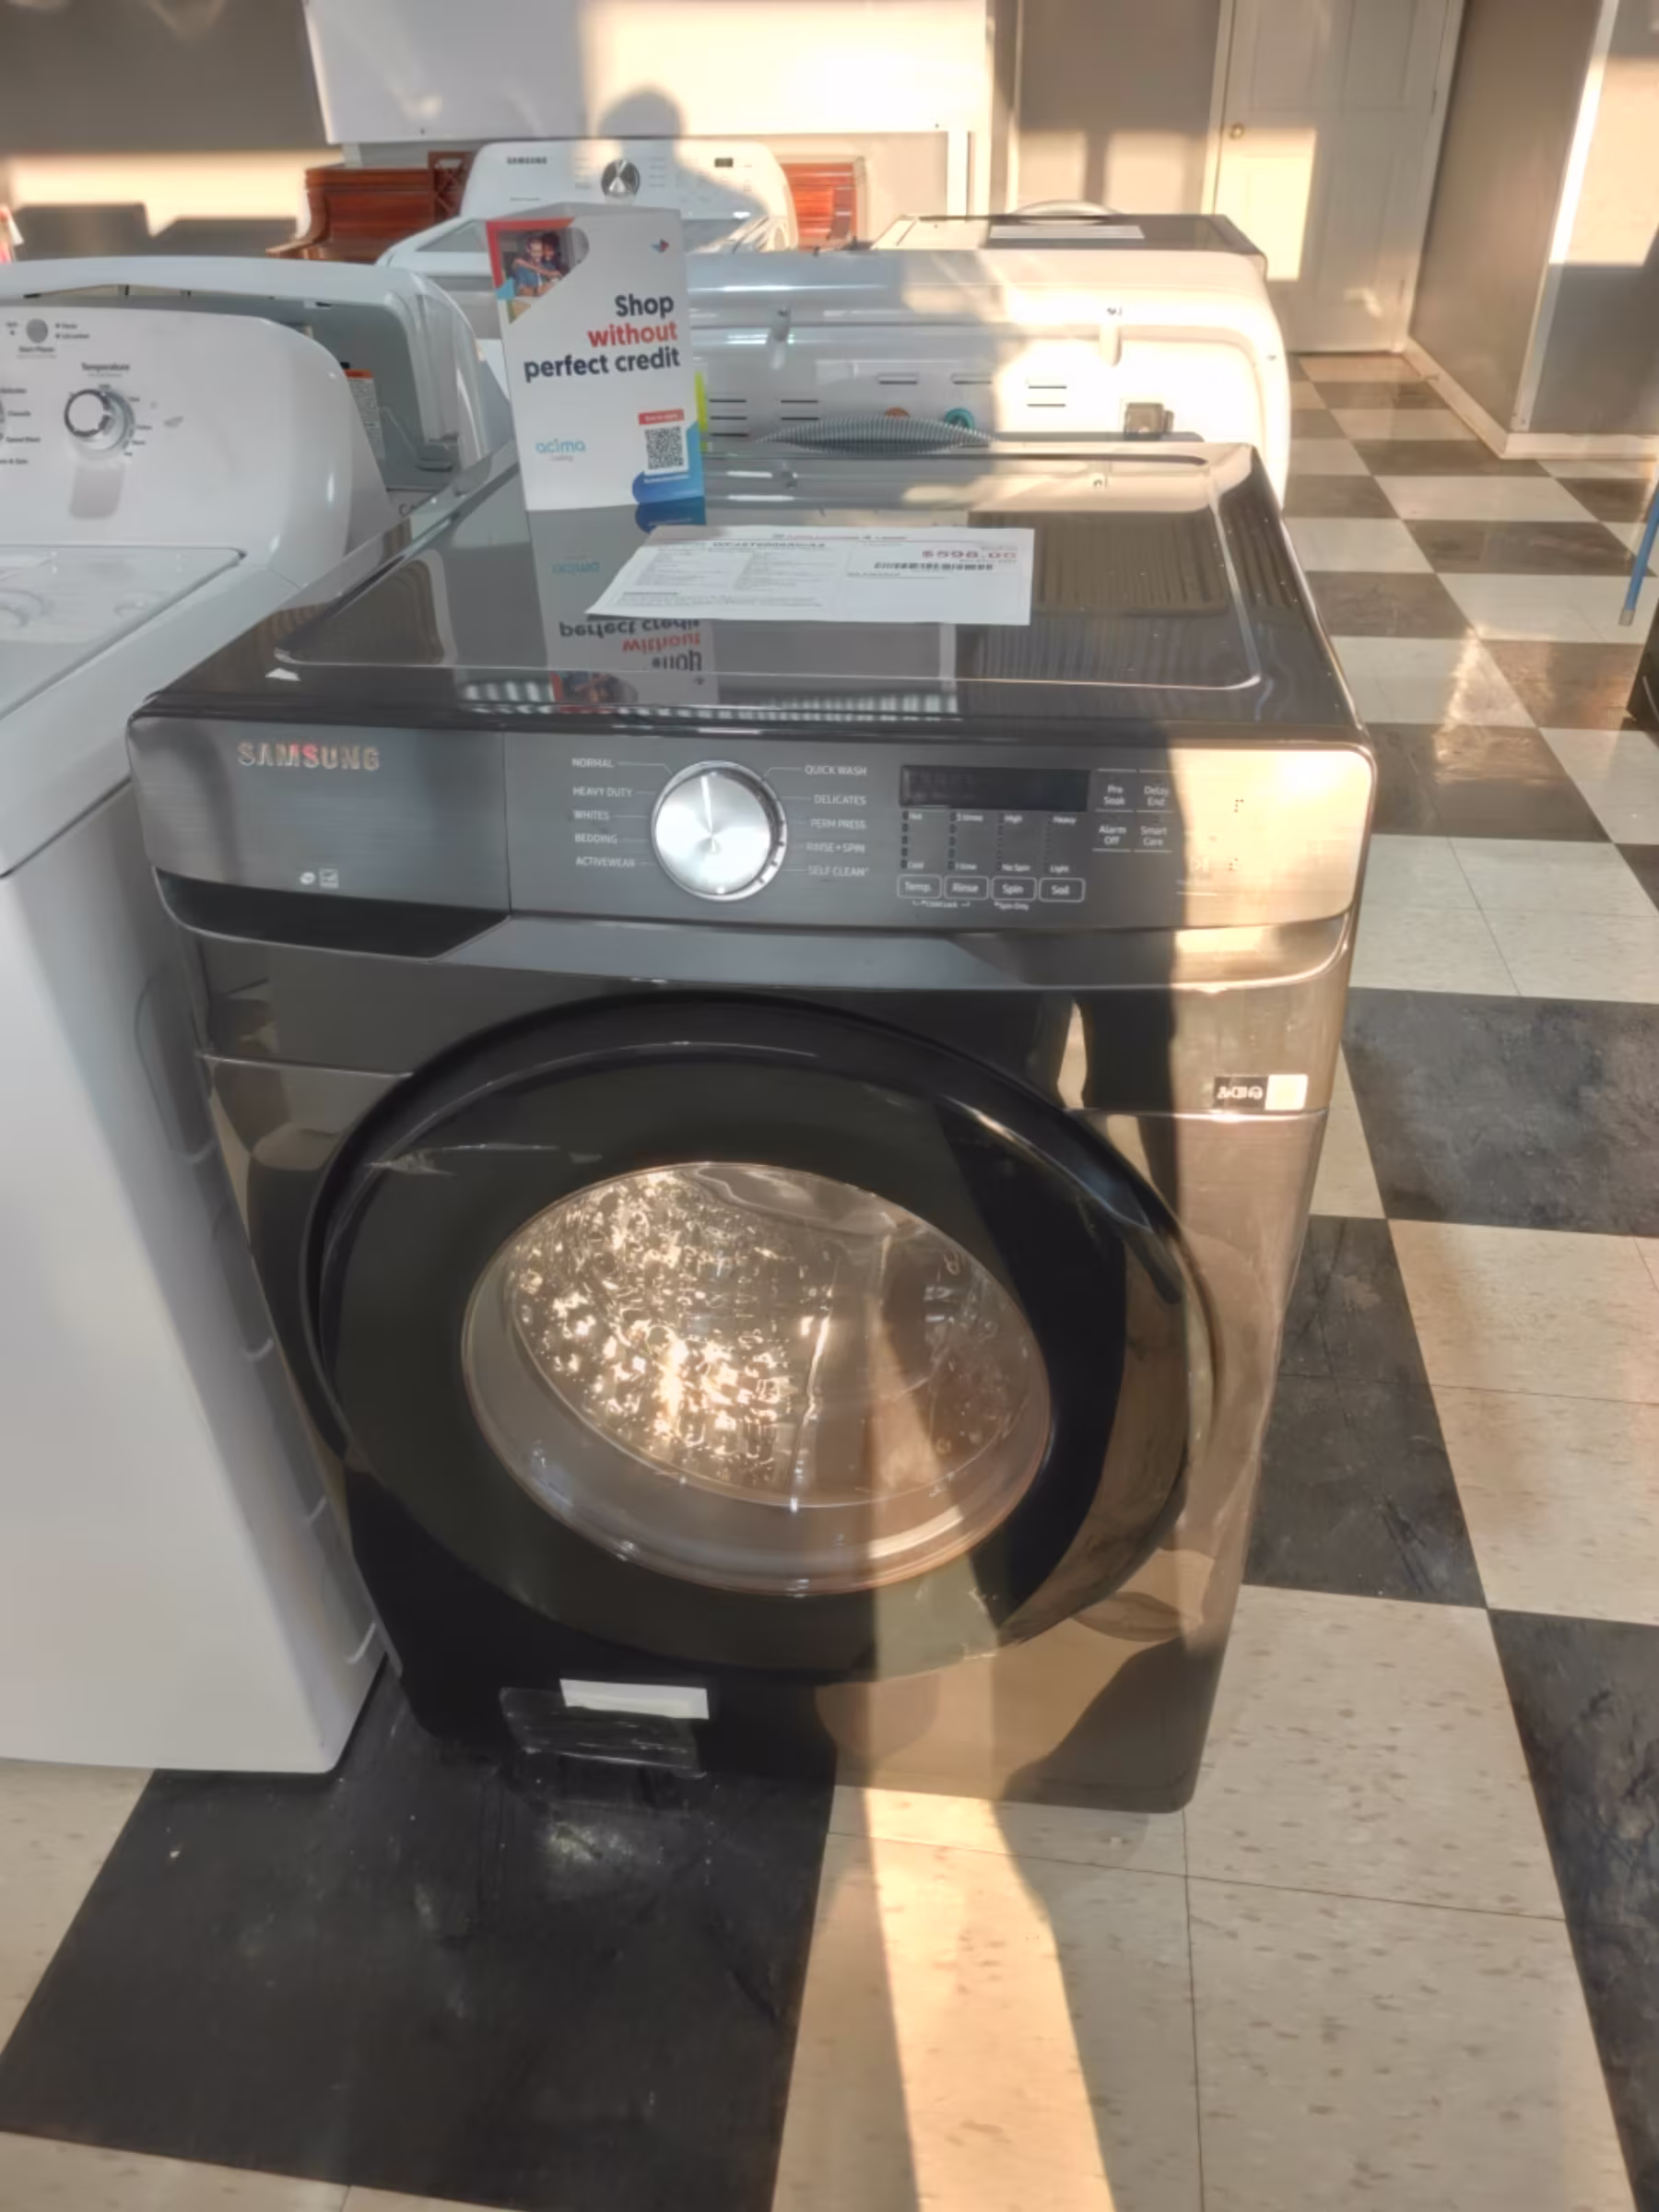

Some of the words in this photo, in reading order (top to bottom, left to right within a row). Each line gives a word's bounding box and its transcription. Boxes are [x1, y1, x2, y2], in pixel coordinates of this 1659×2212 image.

[615, 293, 675, 319] Shop
[587, 321, 678, 348] without
[81, 361, 131, 372] Temperature
[524, 354, 609, 383] perfect
[615, 346, 680, 372] credit
[535, 438, 586, 453] acima
[237, 741, 380, 771] SAMSUNG
[571, 758, 615, 769] NORMAL
[805, 764, 836, 776] QUICK
[838, 765, 867, 776] WASH
[572, 786, 605, 797] HEAVY
[606, 787, 632, 797] DUTY
[1107, 784, 1124, 794] Pre
[1144, 785, 1170, 797] Delay
[813, 794, 867, 806] DELICATES
[1103, 794, 1125, 806] Soak
[1147, 796, 1166, 806] End
[572, 809, 610, 820] WHITES
[810, 818, 836, 829] PERM
[837, 818, 867, 830] PRESS
[1099, 824, 1127, 835] Alarm
[1140, 825, 1167, 836] Smart
[574, 833, 618, 844] BEDDING
[1103, 835, 1120, 845] Off
[1143, 836, 1164, 846] Care
[806, 841, 835, 853] RINSE
[842, 841, 865, 853] SPIN
[575, 856, 636, 869] ACTIVEWEAR
[807, 865, 831, 876] SELF
[951, 882, 980, 894] Rinse
[1002, 883, 1024, 896] Spin
[1051, 884, 1071, 896] Soil
